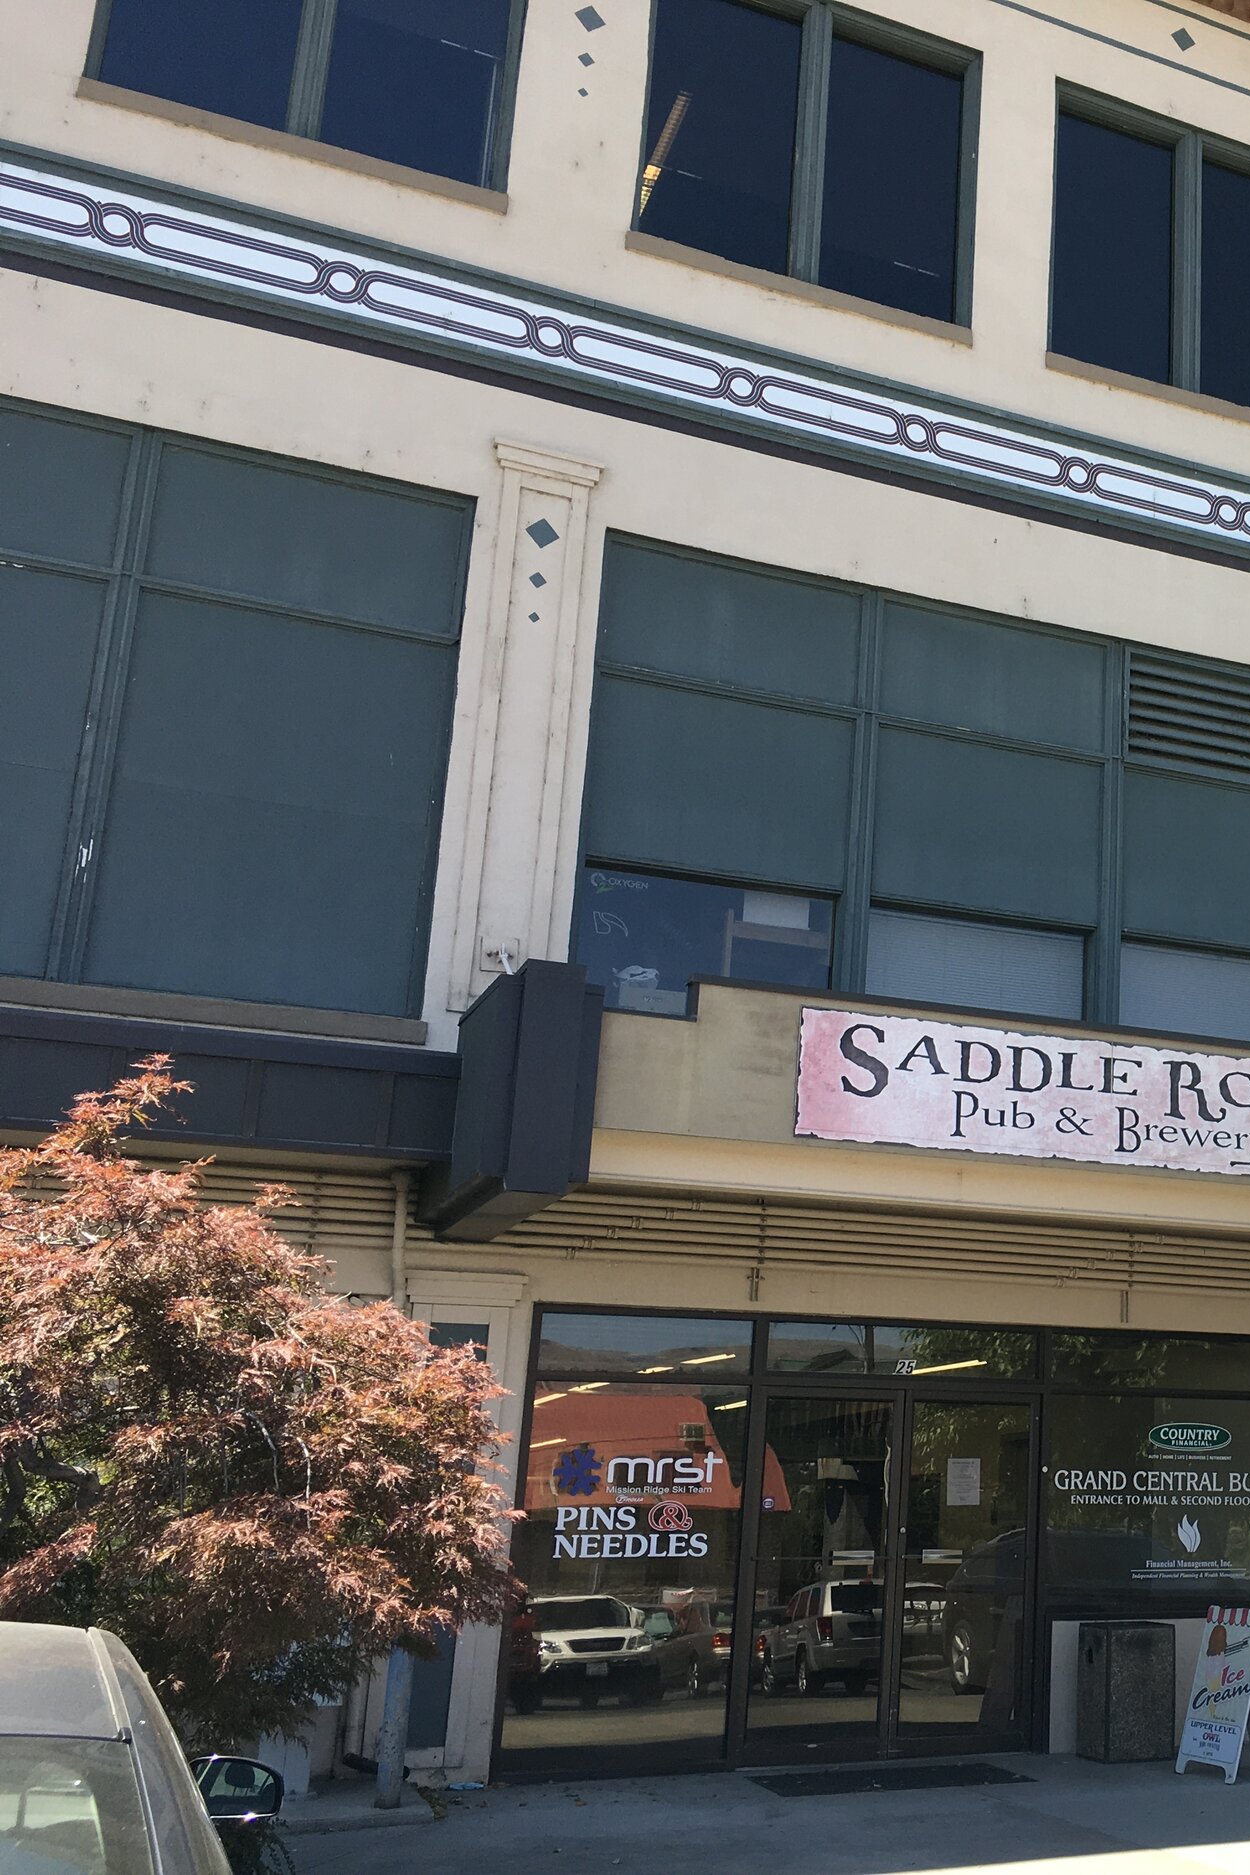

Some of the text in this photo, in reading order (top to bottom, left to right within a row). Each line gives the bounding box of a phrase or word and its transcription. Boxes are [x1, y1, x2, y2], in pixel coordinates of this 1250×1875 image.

[608, 877, 649, 889] OXYGEN
[838, 1022, 1143, 1098] SADDLE
[949, 1089, 1036, 1138] Pub
[1054, 1106, 1094, 1137] &
[896, 1361, 914, 1374] 25
[1160, 1428, 1220, 1440] COUNTRY
[606, 1451, 723, 1484] mrst
[605, 1485, 713, 1495] Mission Ridge Ski Team
[1053, 1469, 1128, 1492] GRAND
[1132, 1470, 1224, 1493] CENTRAL
[1070, 1494, 1124, 1505] ENTRANCE
[1125, 1495, 1140, 1506] TO
[1142, 1494, 1169, 1506] MALL
[1170, 1495, 1179, 1506] &
[1180, 1495, 1223, 1506] SECOND
[554, 1500, 694, 1533] PINS &
[552, 1532, 709, 1559] NEEDLES
[1146, 1559, 1233, 1569] Financial Management, Inc.
[1220, 1665, 1246, 1687] Ice
[1192, 1683, 1250, 1710] Cream
[1190, 1721, 1237, 1735] UPPER LEVEL
